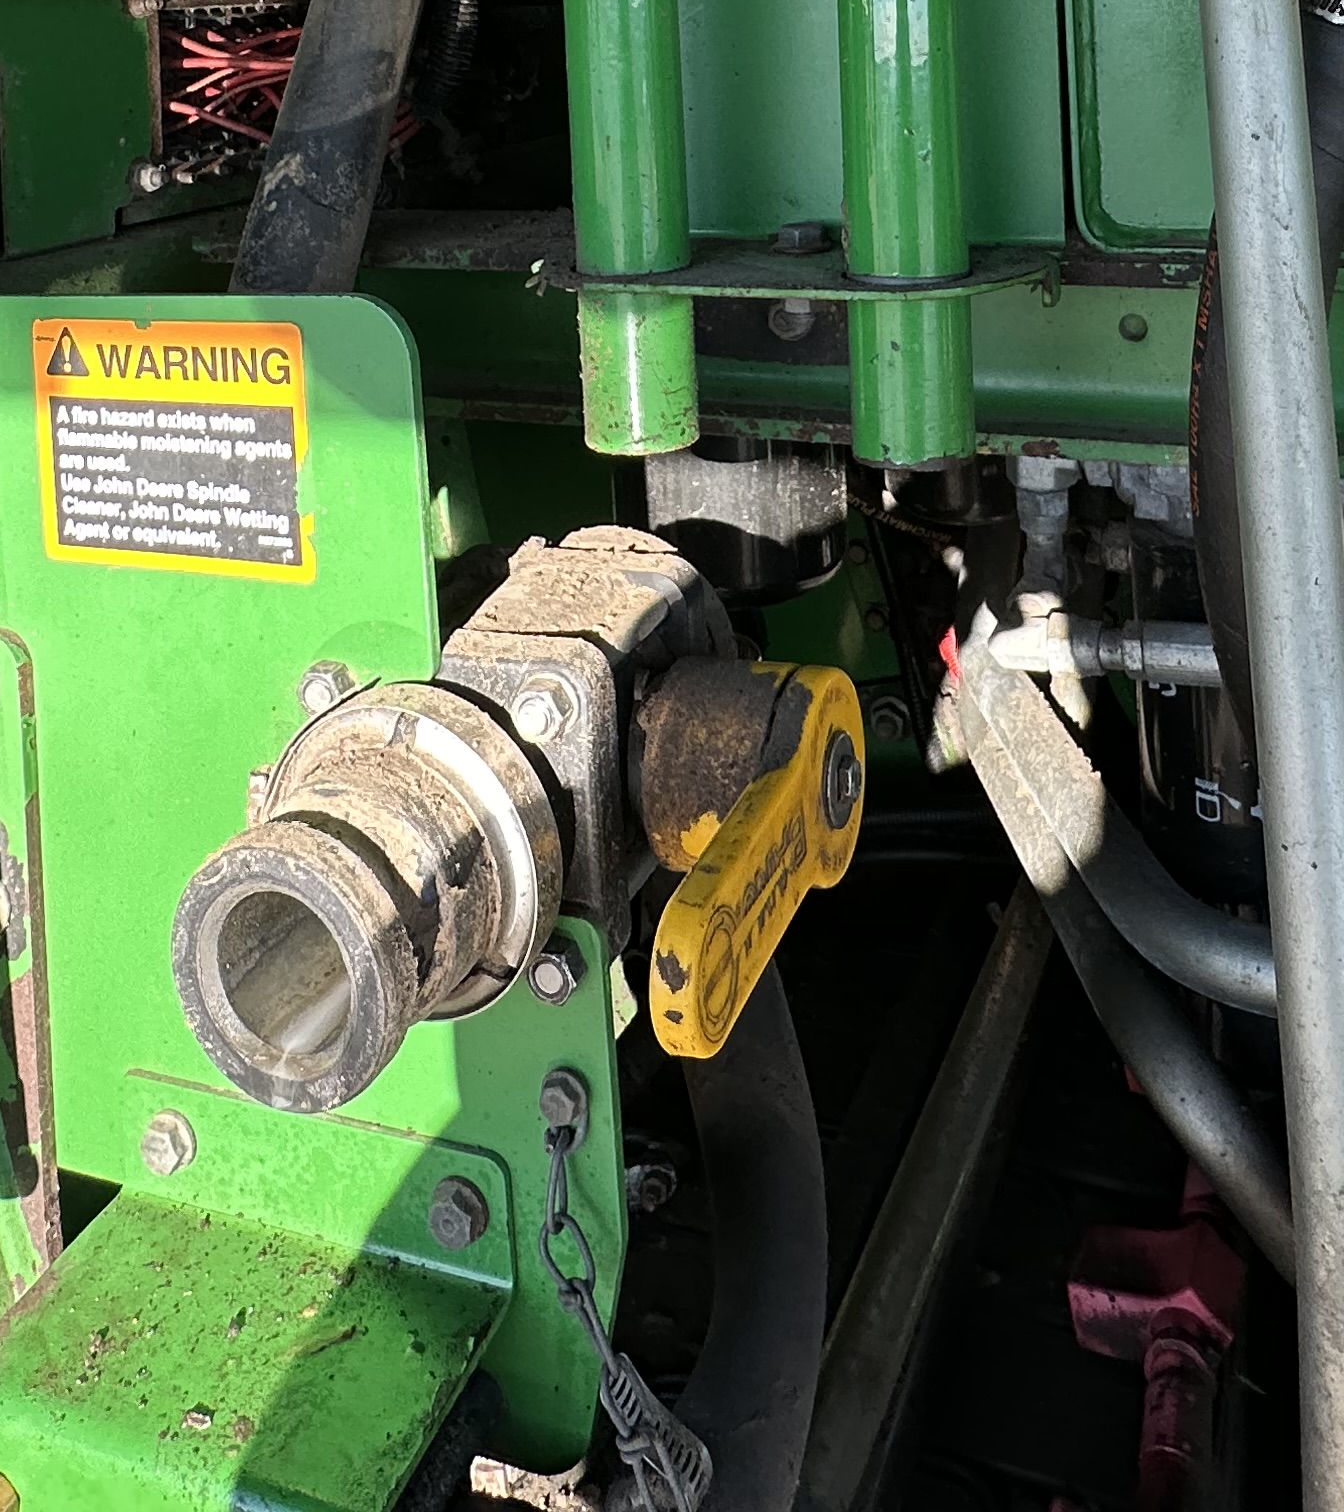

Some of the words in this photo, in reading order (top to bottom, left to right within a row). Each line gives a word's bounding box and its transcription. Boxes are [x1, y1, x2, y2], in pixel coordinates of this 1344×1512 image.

[96, 344, 291, 385] WARNING
[56, 406, 70, 425] A
[71, 406, 98, 426] fire
[101, 406, 154, 428] hazard
[158, 409, 206, 432] exists
[210, 414, 255, 434] when
[57, 428, 138, 452] flammable
[141, 432, 232, 458] moistening
[235, 440, 292, 461] agents
[59, 453, 84, 470] are
[88, 453, 130, 473] used.
[61, 474, 91, 494] Use
[94, 475, 133, 497] John
[136, 478, 184, 500] Deere
[187, 480, 250, 504] Spindle
[62, 496, 126, 520] Cleaner,
[129, 502, 169, 522] John
[173, 503, 220, 525] Deere
[225, 508, 288, 533] Wetting
[64, 518, 110, 542] Agent
[112, 522, 130, 540] or
